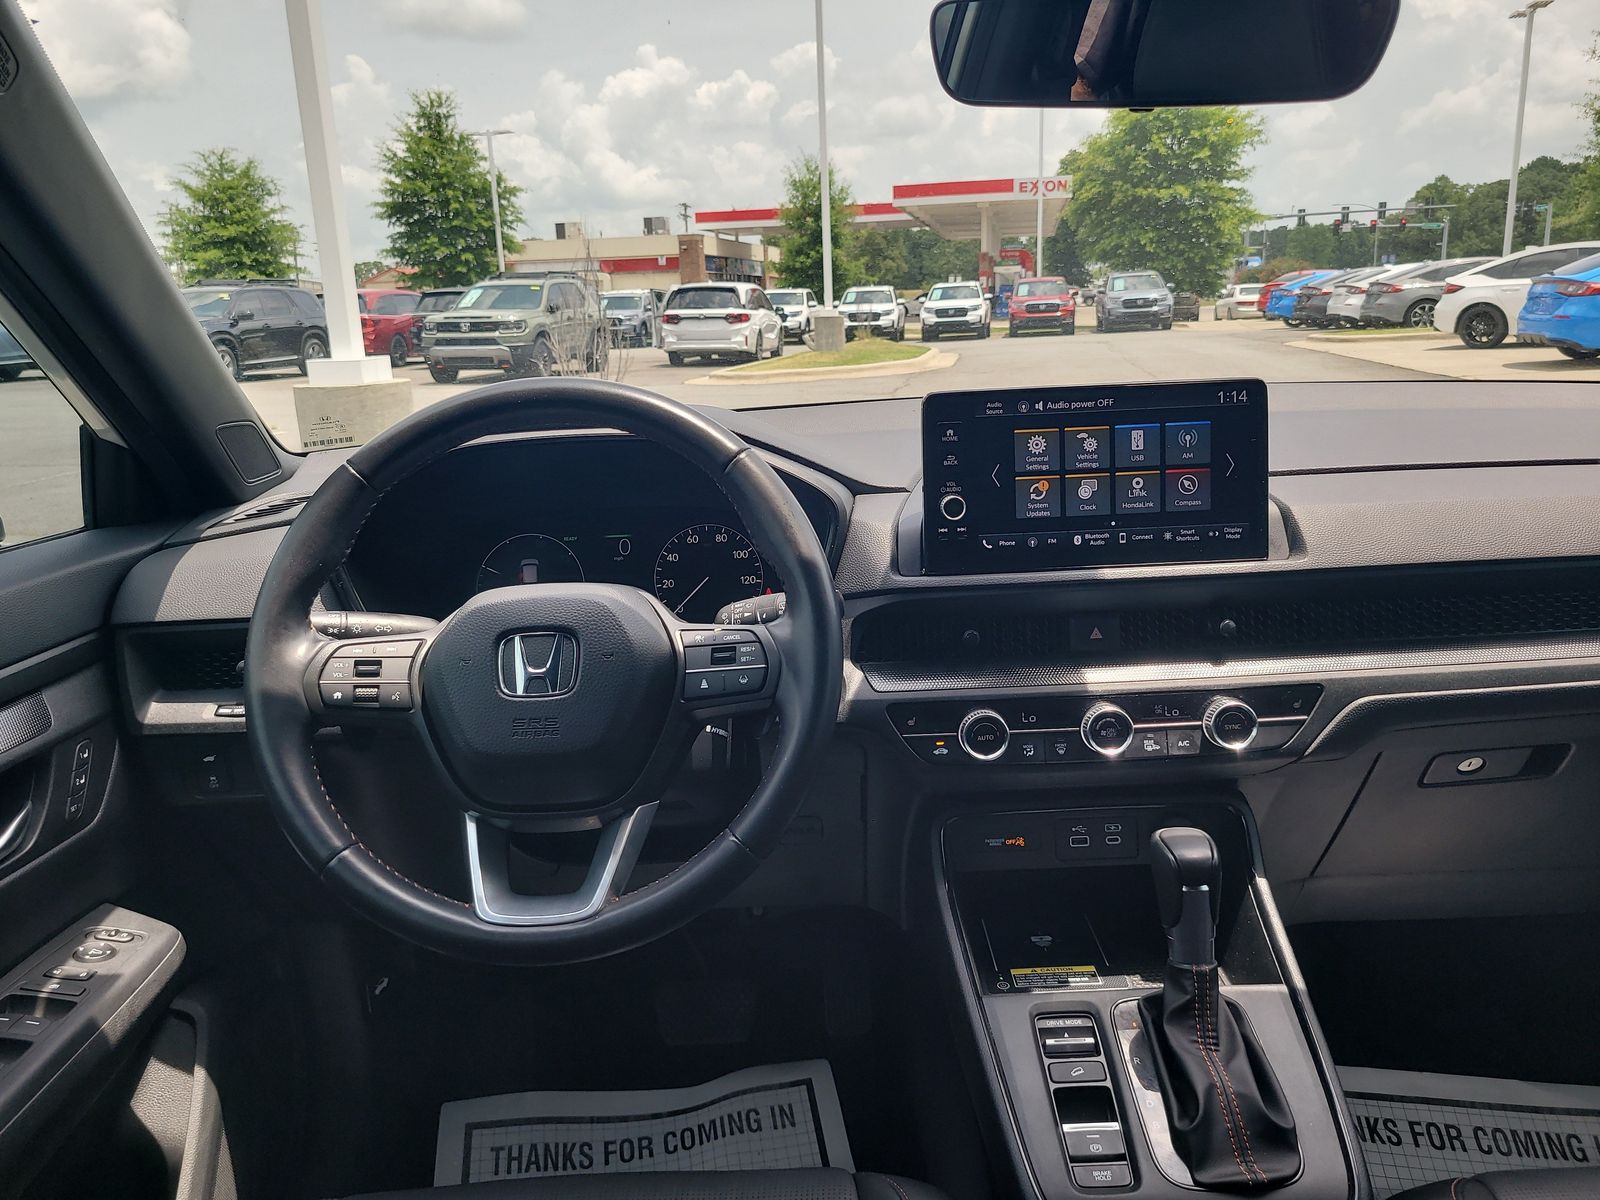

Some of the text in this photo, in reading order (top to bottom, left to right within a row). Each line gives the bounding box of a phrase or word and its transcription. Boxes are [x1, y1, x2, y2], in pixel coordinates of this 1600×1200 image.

[1217, 390, 1248, 403] 1:14
[1046, 398, 1115, 410] Audio power OFF
[1130, 454, 1145, 462] USB
[1025, 463, 1050, 471] Settings
[1075, 461, 1100, 469] Settings
[1027, 502, 1049, 510] System
[1079, 503, 1097, 511] Clock
[1122, 501, 1154, 509] HondaLink
[1174, 499, 1202, 507] Compass
[1026, 509, 1051, 518] Updates
[686, 534, 699, 544] 60
[715, 533, 728, 543] 80
[1084, 532, 1110, 540] Bluetooth
[618, 538, 631, 555] 0
[666, 553, 679, 562] 40
[732, 550, 749, 559] 100
[662, 579, 675, 589] 20
[740, 575, 756, 585] 120
[1021, 712, 1037, 723] Lo
[512, 718, 560, 729] SRS
[512, 729, 560, 739] AIRBAG
[490, 1103, 797, 1176] THANKS FOR COMING IN
[1408, 1121, 1469, 1153] FOR
[1473, 1125, 1590, 1164] COMING
